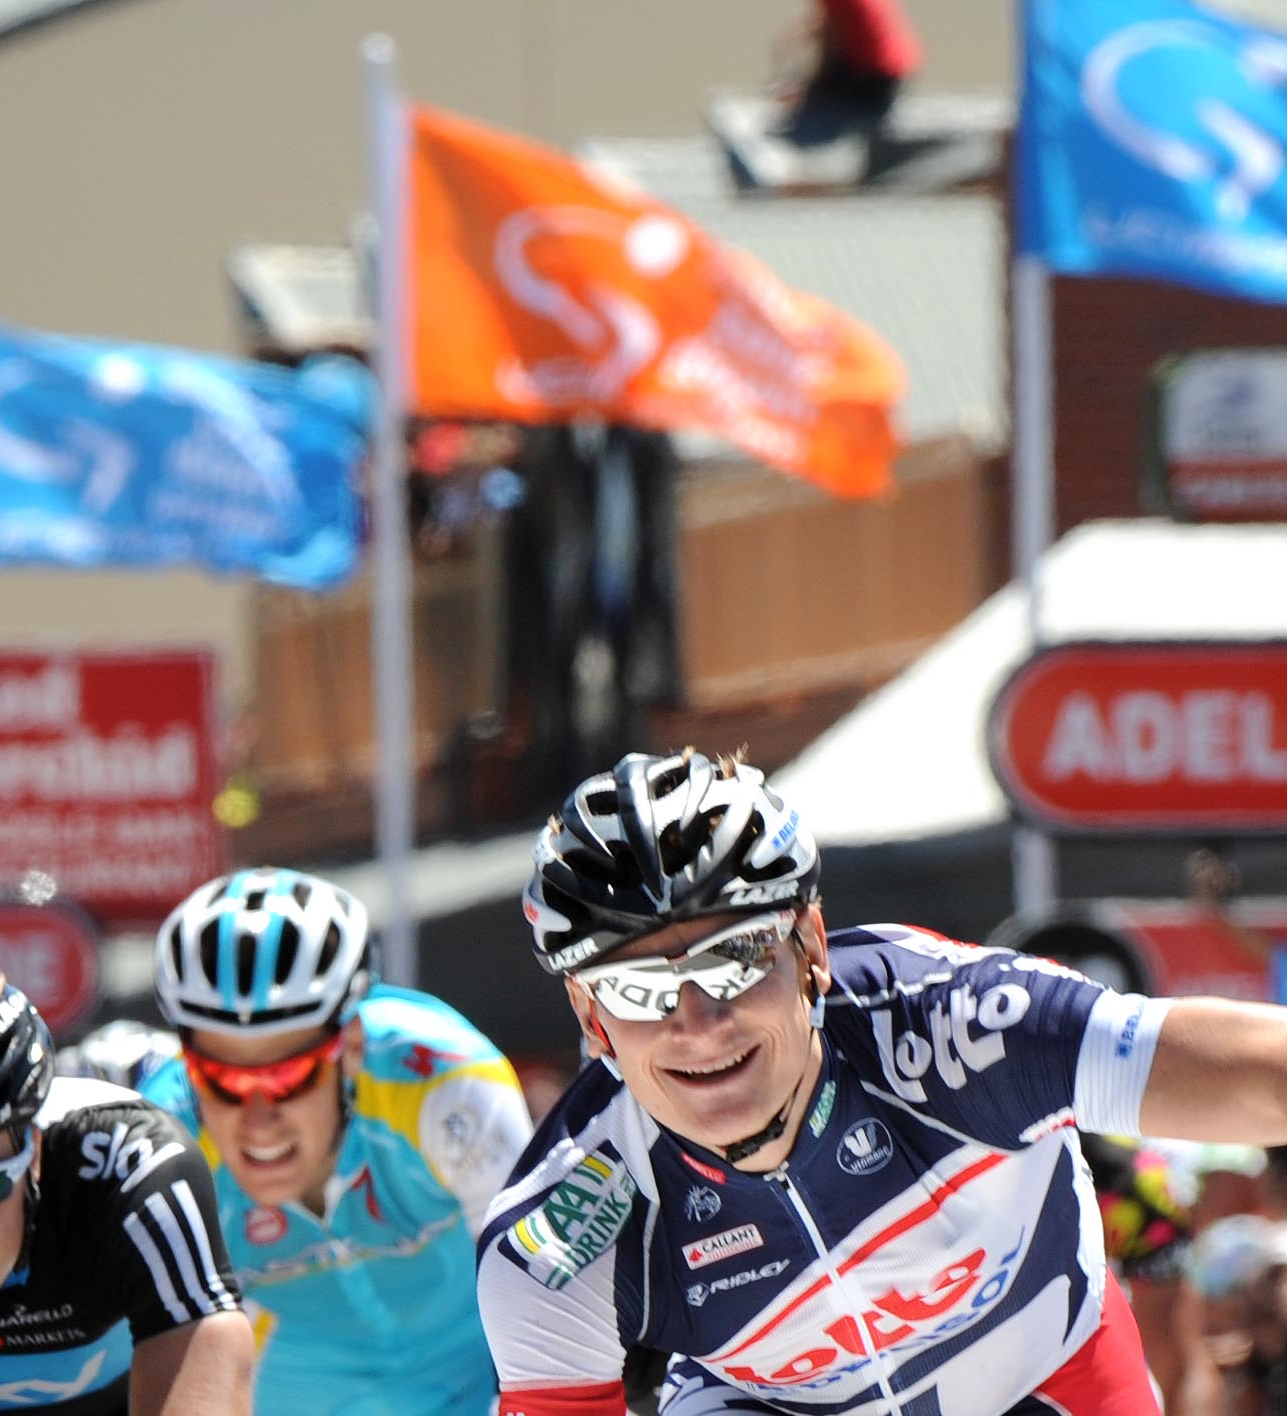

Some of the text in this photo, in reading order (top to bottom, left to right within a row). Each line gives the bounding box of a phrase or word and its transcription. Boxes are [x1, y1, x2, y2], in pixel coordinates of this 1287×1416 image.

[546, 937, 599, 970] LAZER
[871, 980, 1031, 1103] lotto
[78, 1121, 187, 1195] sky
[701, 1226, 756, 1254] CALLANT
